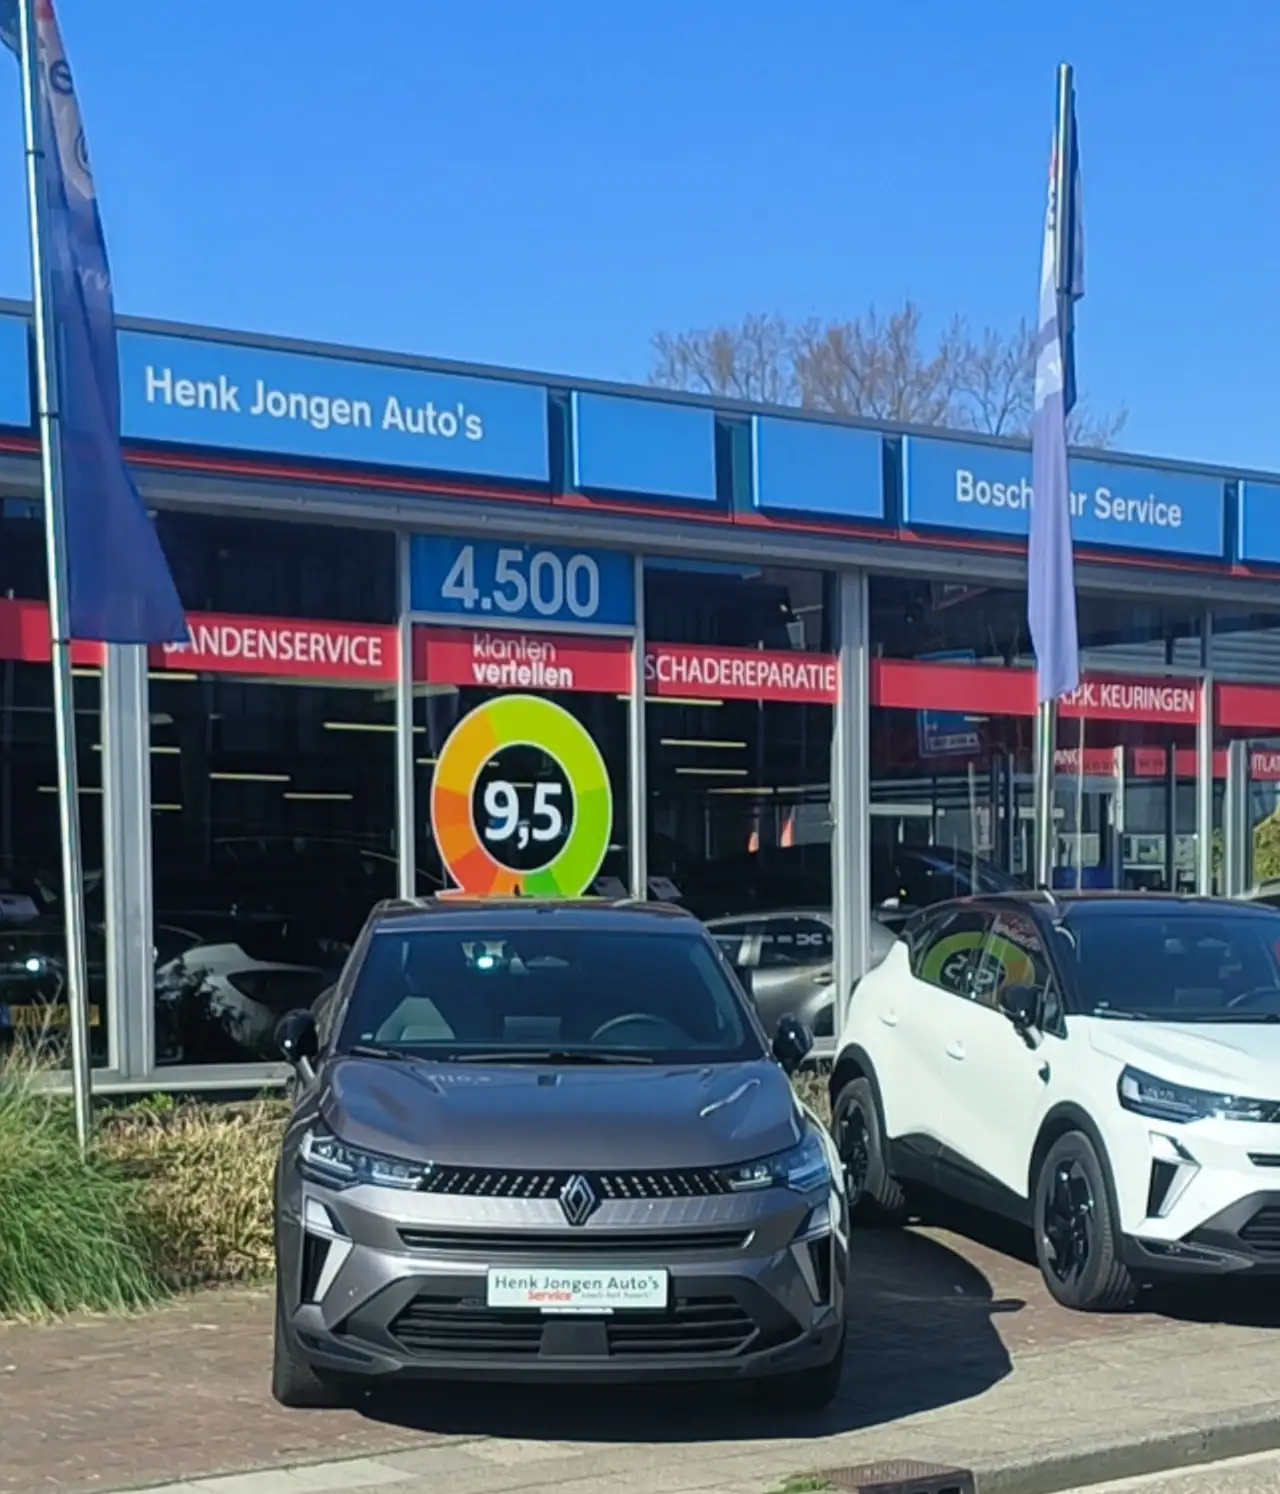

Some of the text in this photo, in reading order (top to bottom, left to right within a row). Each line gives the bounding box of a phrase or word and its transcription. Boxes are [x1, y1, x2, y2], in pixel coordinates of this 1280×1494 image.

[145, 366, 483, 440] Henk Jongen Auto's
[956, 469, 1033, 510] Bosch
[1094, 487, 1182, 528] Service
[442, 545, 600, 617] 4.500
[163, 624, 383, 667] ANDENSERVICE
[473, 633, 555, 662] klanten
[472, 660, 573, 688] vertellen
[645, 655, 836, 690] SCHADEREPARATIE
[1101, 684, 1195, 713] KEURINGEN
[484, 781, 562, 850] 9,5
[495, 1275, 538, 1290] Henk
[543, 1276, 603, 1293] Jongen
